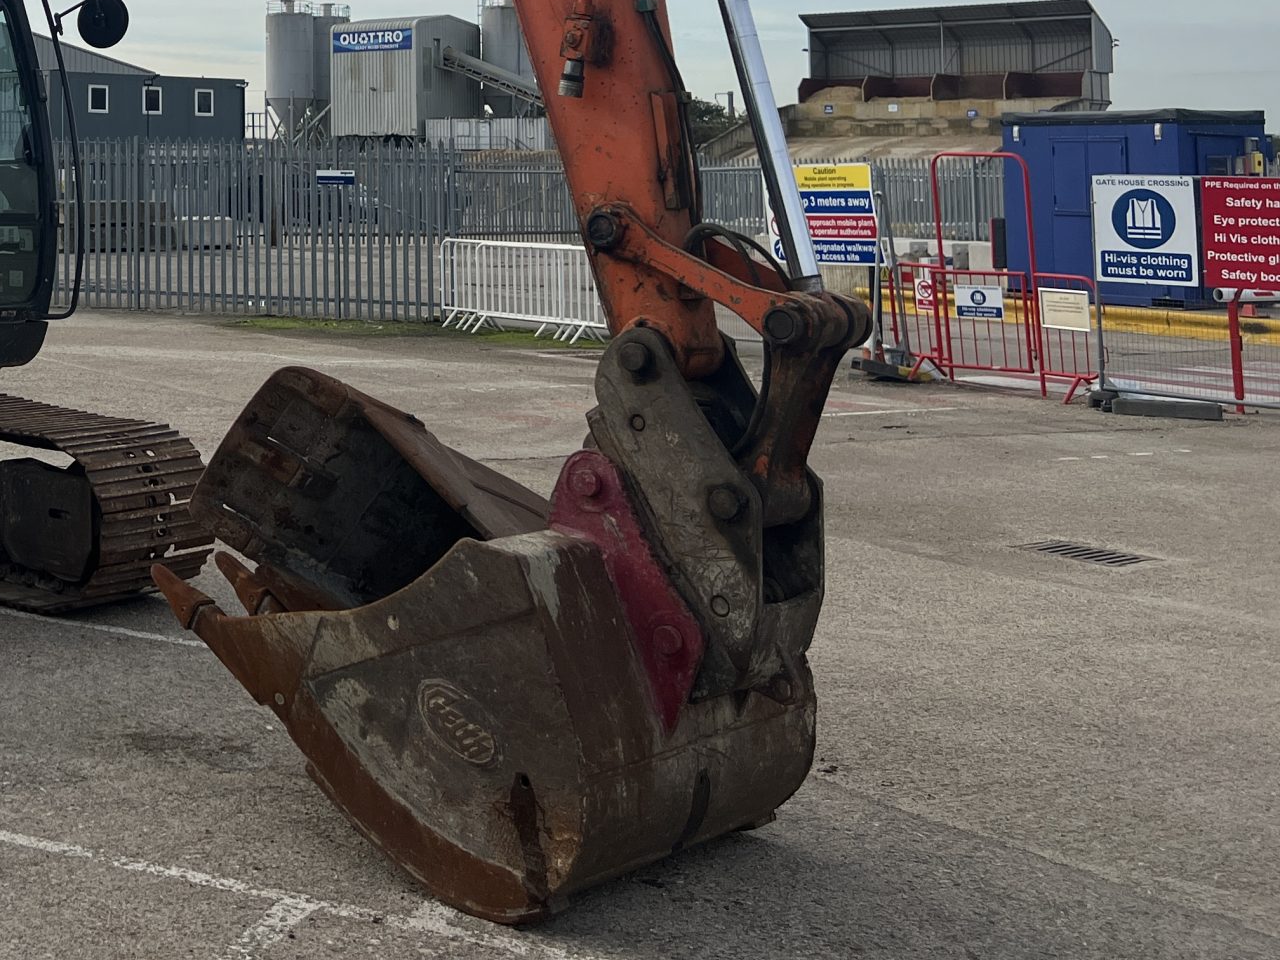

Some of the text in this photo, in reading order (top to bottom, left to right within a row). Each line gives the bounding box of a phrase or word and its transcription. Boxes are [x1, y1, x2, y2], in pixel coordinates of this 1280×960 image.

[340, 30, 403, 45] QUATTRO
[813, 167, 837, 175] Caution
[1095, 178, 1116, 186] GATE
[1147, 179, 1190, 187] CROSSING
[1205, 181, 1222, 189] PPE
[1223, 181, 1259, 190] Required
[810, 196, 816, 207] 3
[817, 197, 846, 207] meters
[847, 198, 870, 209] away
[1226, 197, 1263, 210] Safety
[836, 219, 857, 227] mobile
[1213, 214, 1235, 227] Eye
[1214, 233, 1227, 243] Hi
[1229, 233, 1248, 244] Vis
[846, 253, 860, 261] site
[1104, 253, 1188, 269] Hi-vis clothing
[1207, 250, 1265, 263] Protective
[1107, 266, 1187, 278] must be worn
[1221, 269, 1258, 283] Safety
